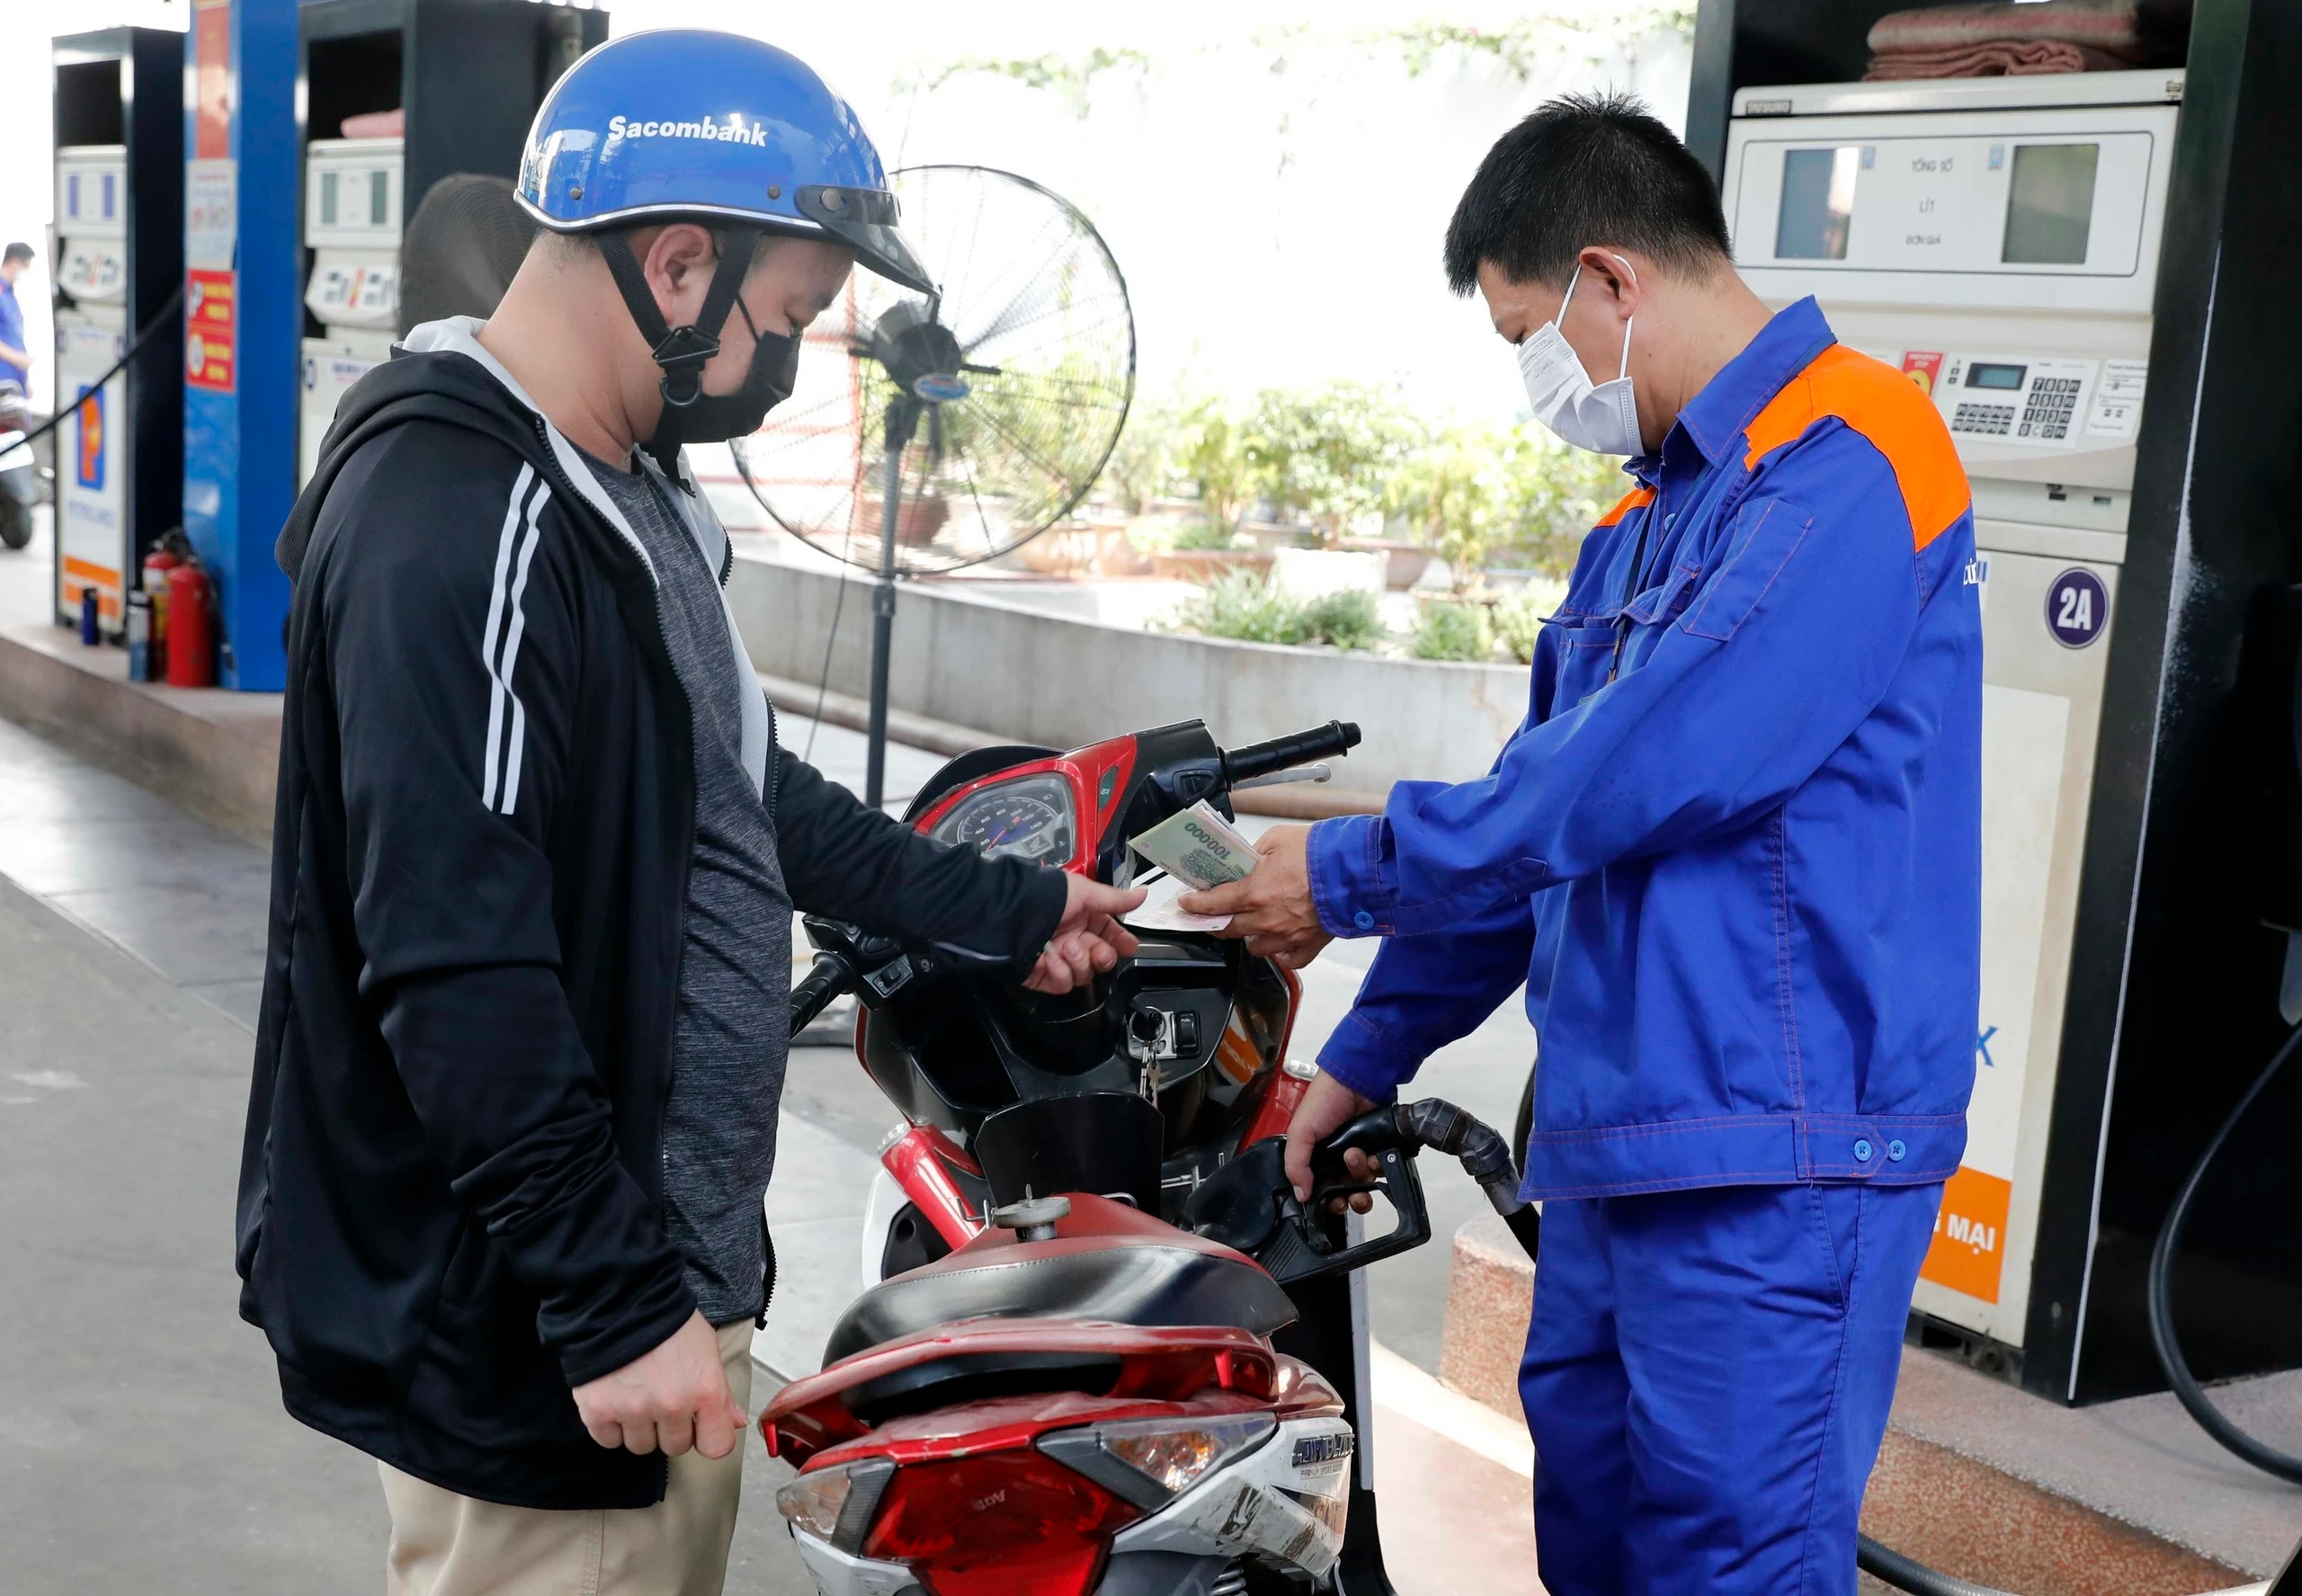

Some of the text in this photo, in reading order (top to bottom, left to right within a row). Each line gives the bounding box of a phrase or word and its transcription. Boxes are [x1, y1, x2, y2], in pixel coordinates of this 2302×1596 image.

[608, 114, 767, 147] Sacombank
[2057, 586, 2092, 631] 2A
[1947, 1213, 1996, 1255] MẠI
